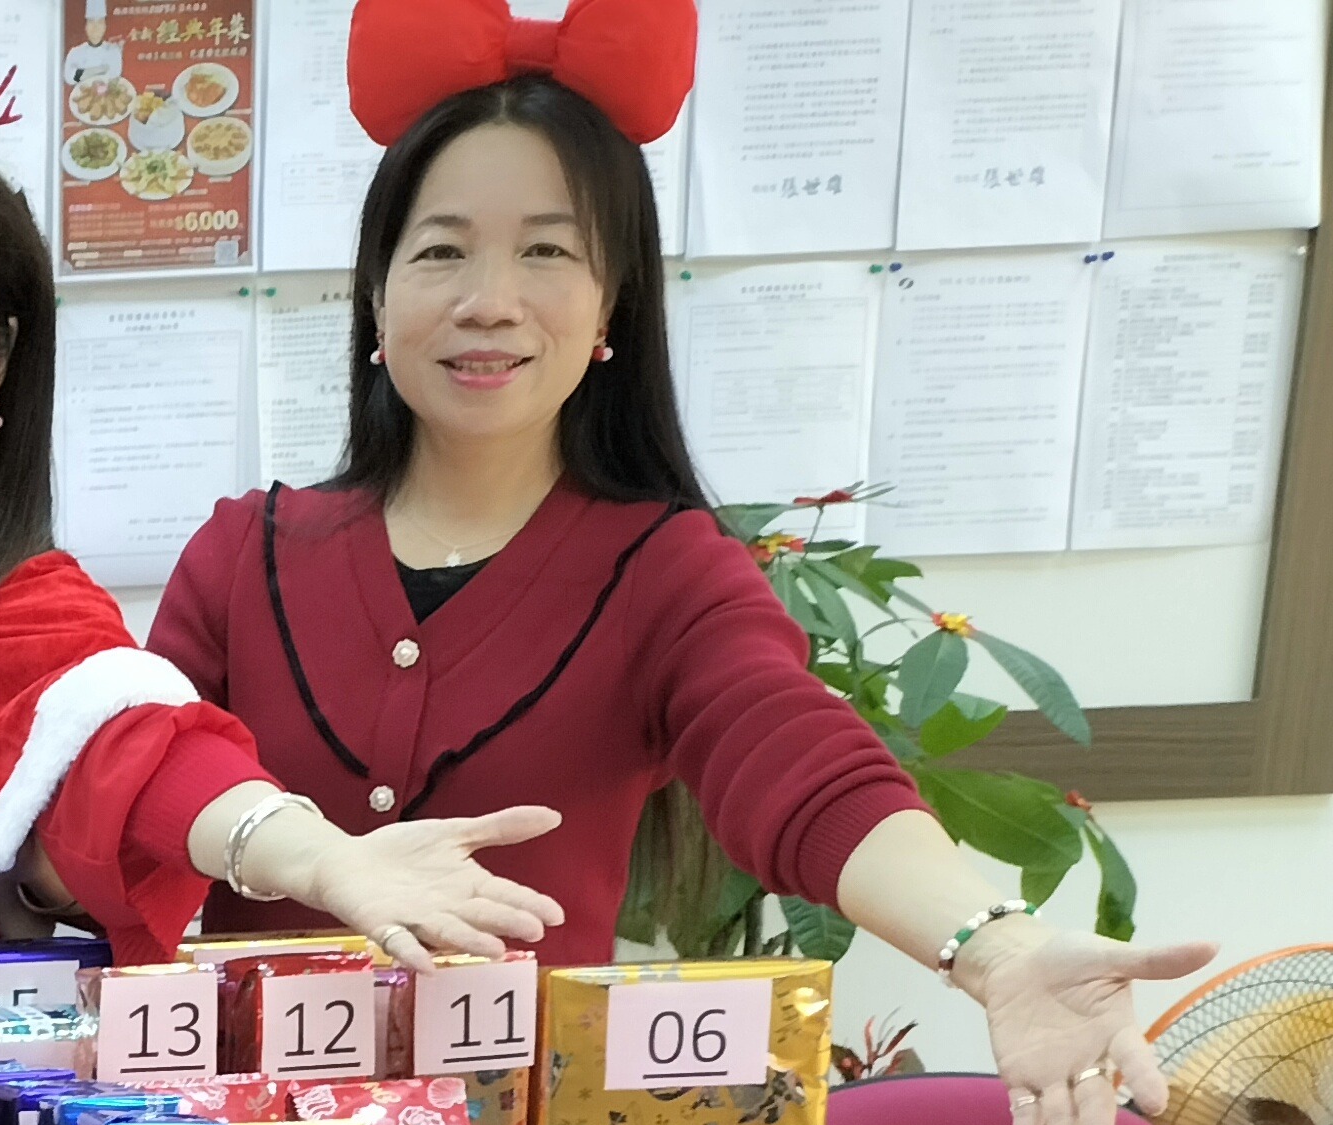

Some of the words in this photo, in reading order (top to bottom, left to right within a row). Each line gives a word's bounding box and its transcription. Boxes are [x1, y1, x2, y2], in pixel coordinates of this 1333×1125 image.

[127, 1001, 202, 1059] 13
[284, 999, 357, 1058] 12
[449, 989, 526, 1050] 11
[648, 1008, 727, 1064] 06
